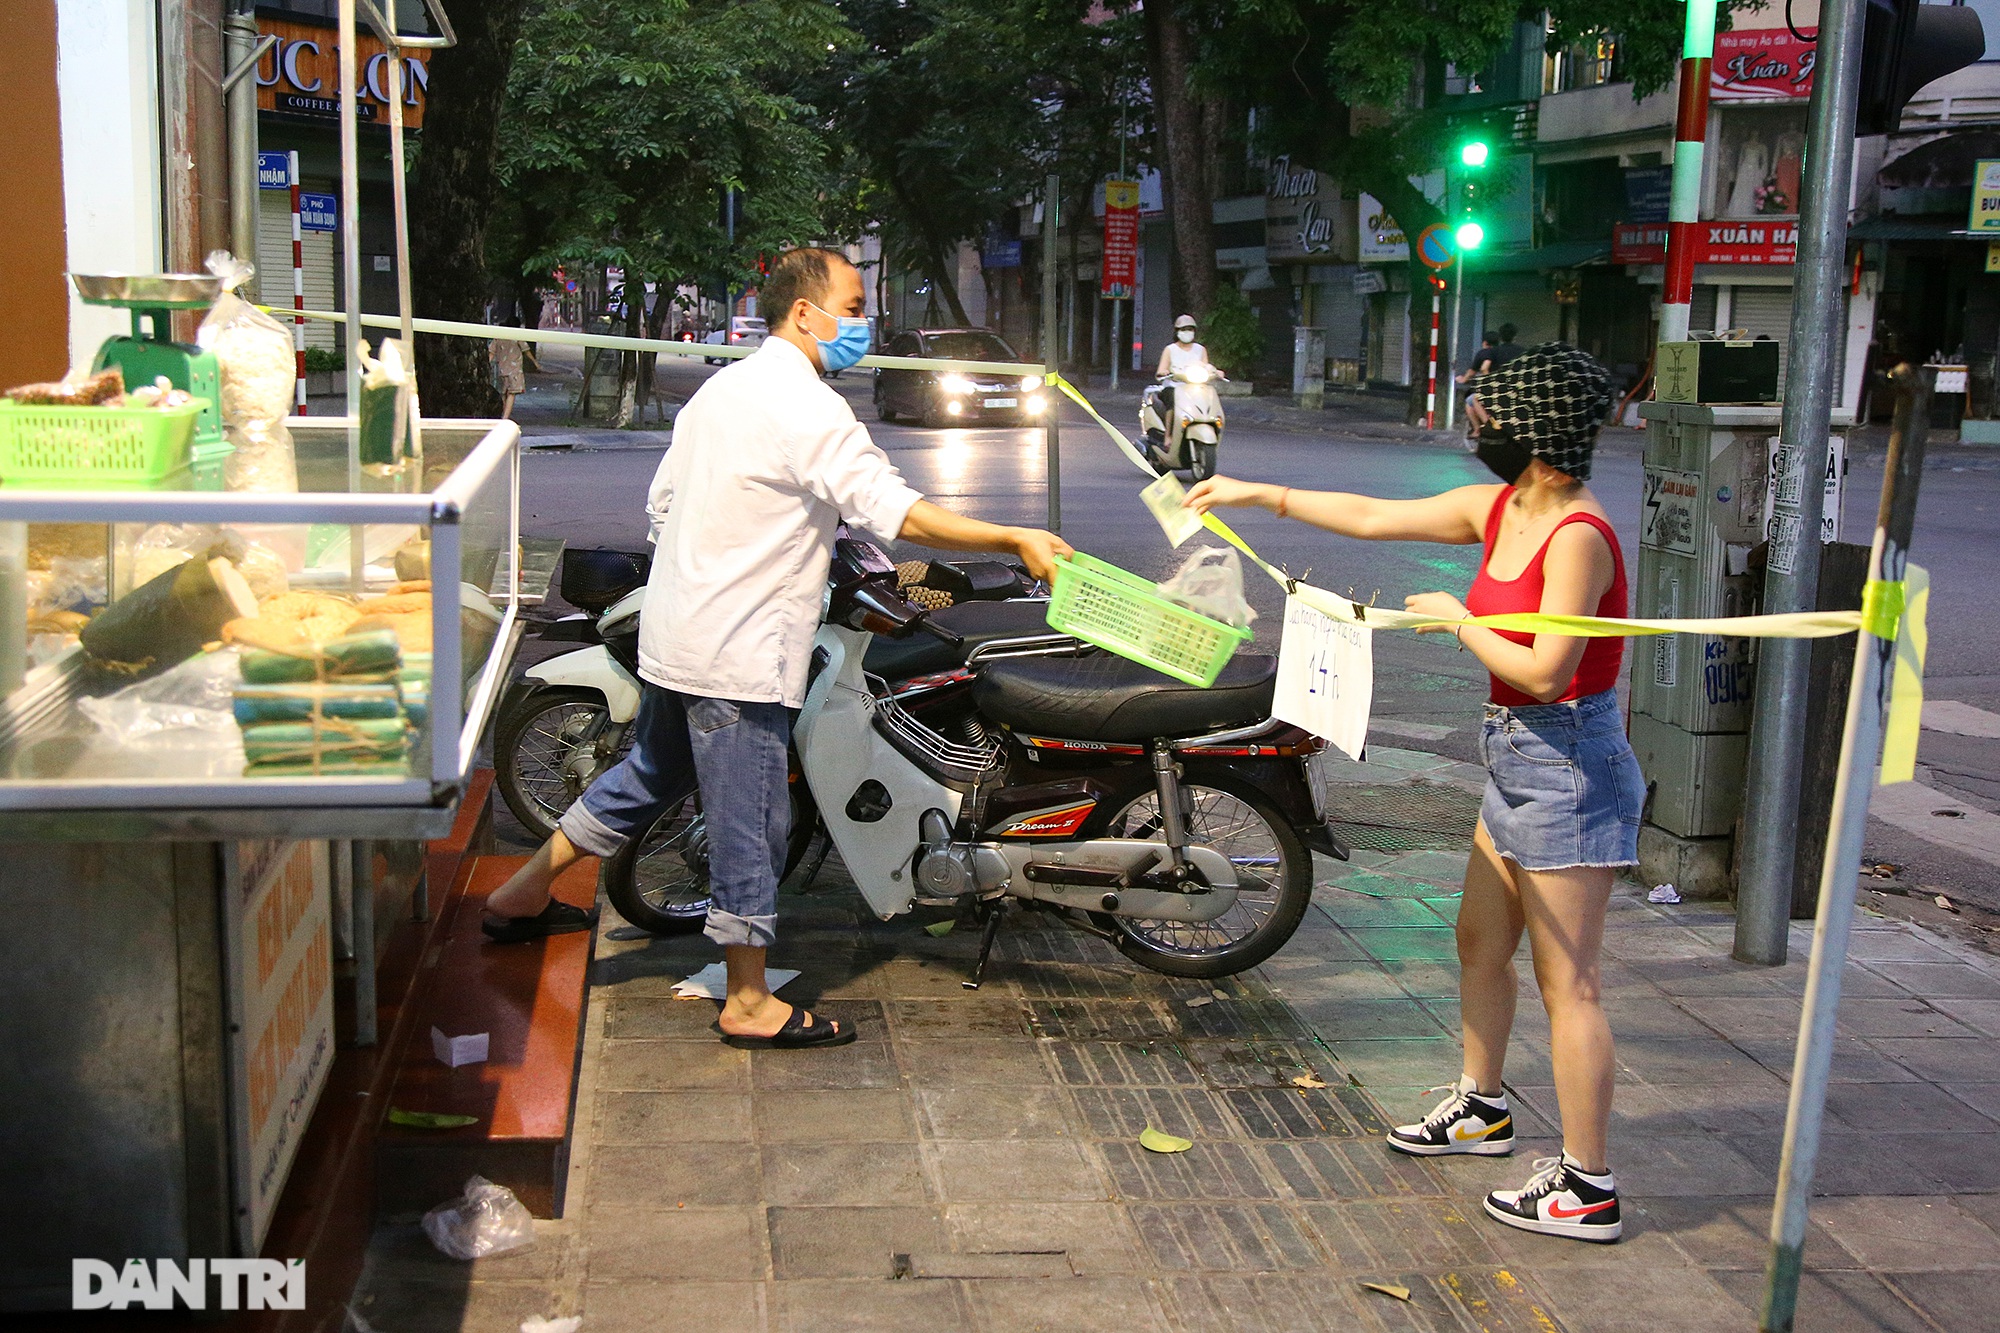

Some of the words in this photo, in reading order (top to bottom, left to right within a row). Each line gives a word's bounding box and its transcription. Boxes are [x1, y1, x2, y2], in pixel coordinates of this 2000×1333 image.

[1723, 52, 1790, 86] Xuân
[288, 96, 332, 111] COFFEE
[310, 199, 324, 209] PHỐ
[1708, 224, 1765, 244] XUÂN
[1063, 741, 1108, 751] HONDA
[1007, 822, 1062, 831] Dream
